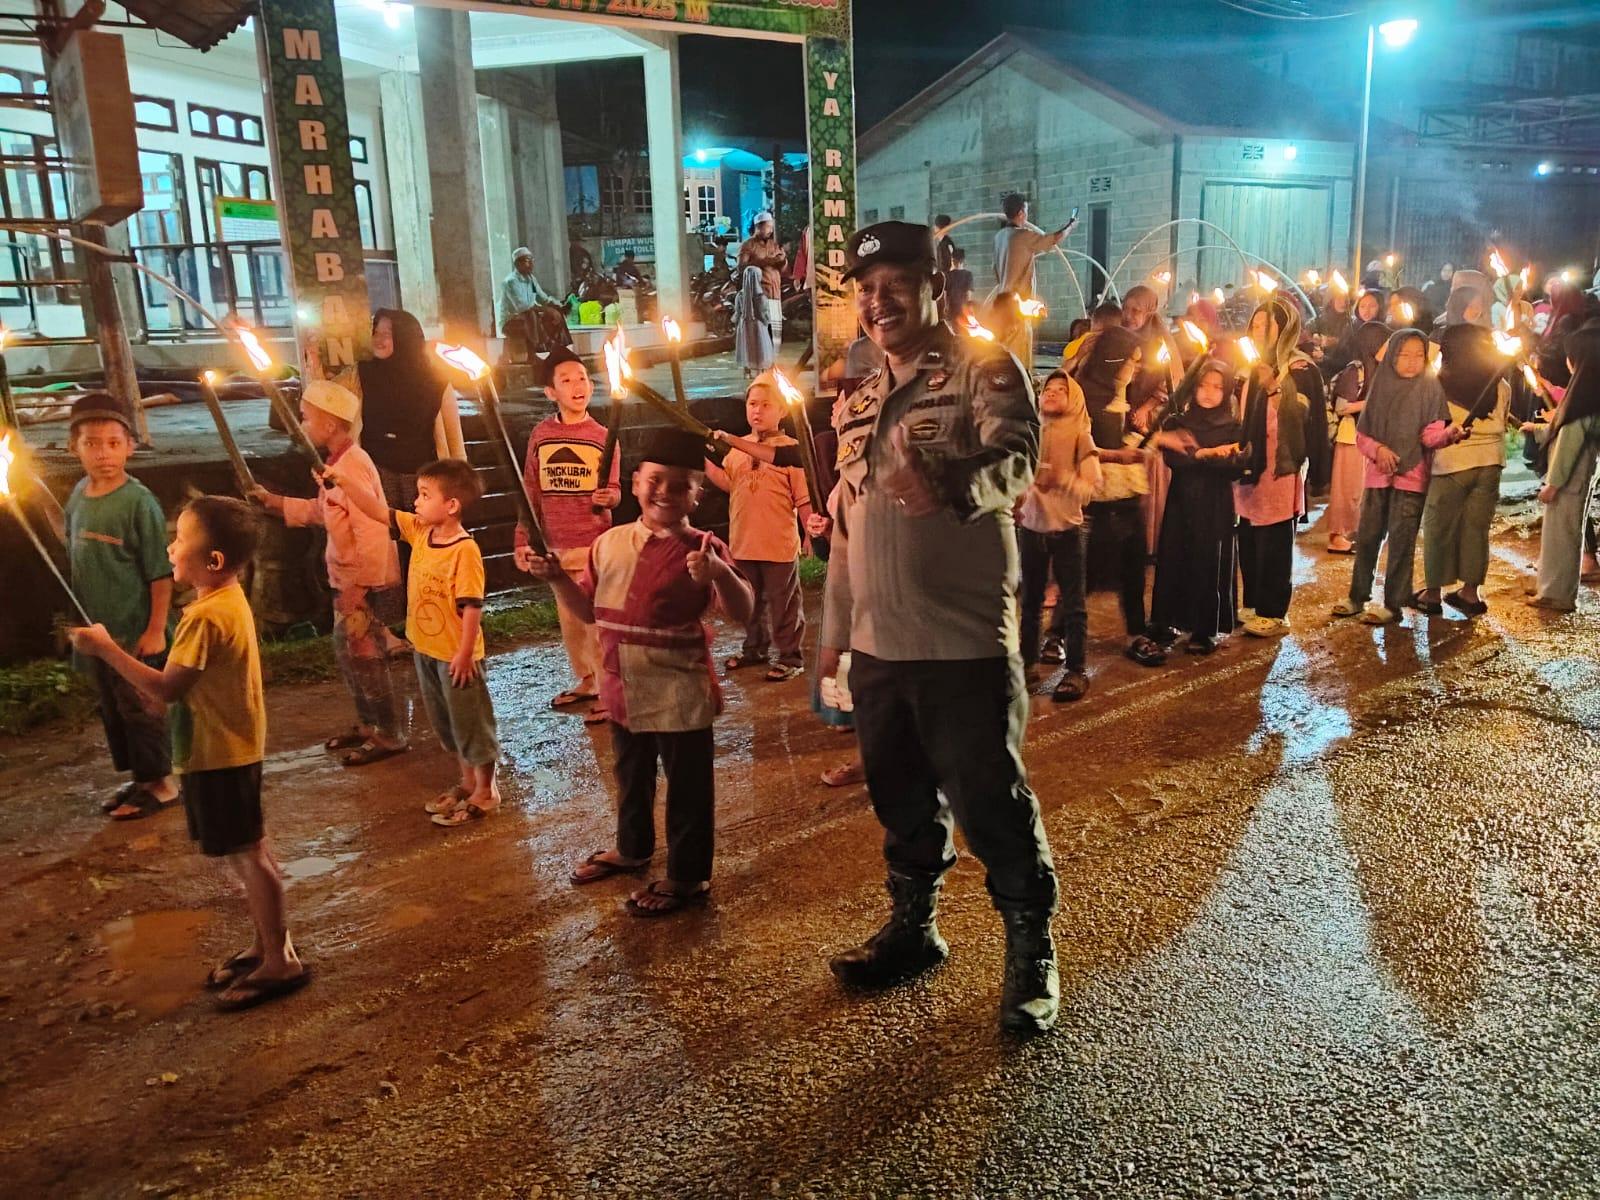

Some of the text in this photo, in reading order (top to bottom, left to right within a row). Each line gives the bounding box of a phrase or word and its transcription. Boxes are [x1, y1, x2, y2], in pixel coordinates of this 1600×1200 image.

[822, 71, 841, 117] YA
[282, 27, 354, 366] MARHABAN
[542, 466, 592, 478] TANGKUBAN
